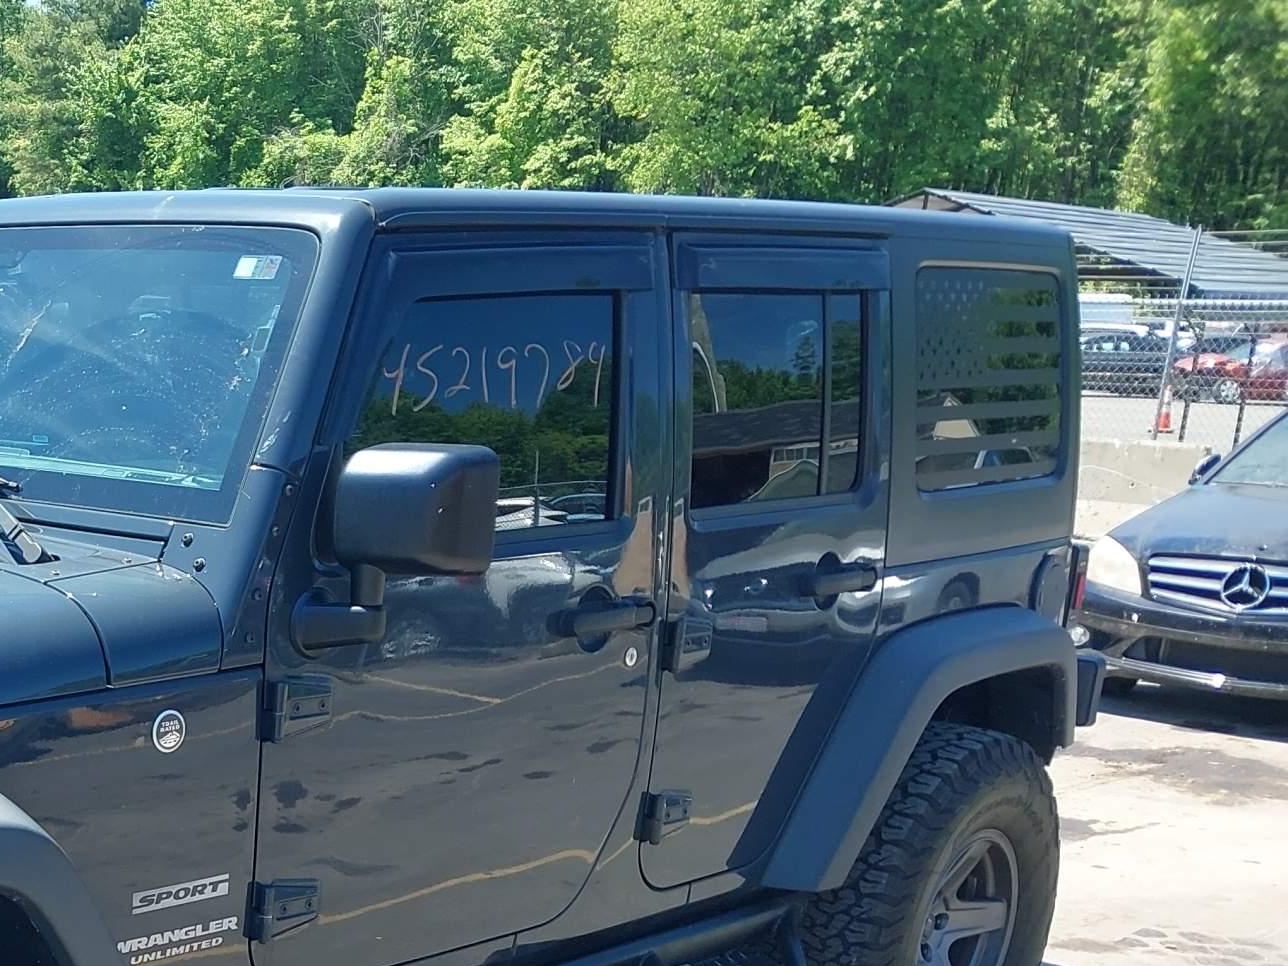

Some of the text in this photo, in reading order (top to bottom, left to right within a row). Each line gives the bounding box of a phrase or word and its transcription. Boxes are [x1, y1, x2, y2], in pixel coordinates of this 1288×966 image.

[383, 339, 606, 416] 45219784
[136, 879, 225, 909] SPORT
[117, 916, 238, 953] WRANGLER
[130, 937, 223, 965] UNLIMITED
